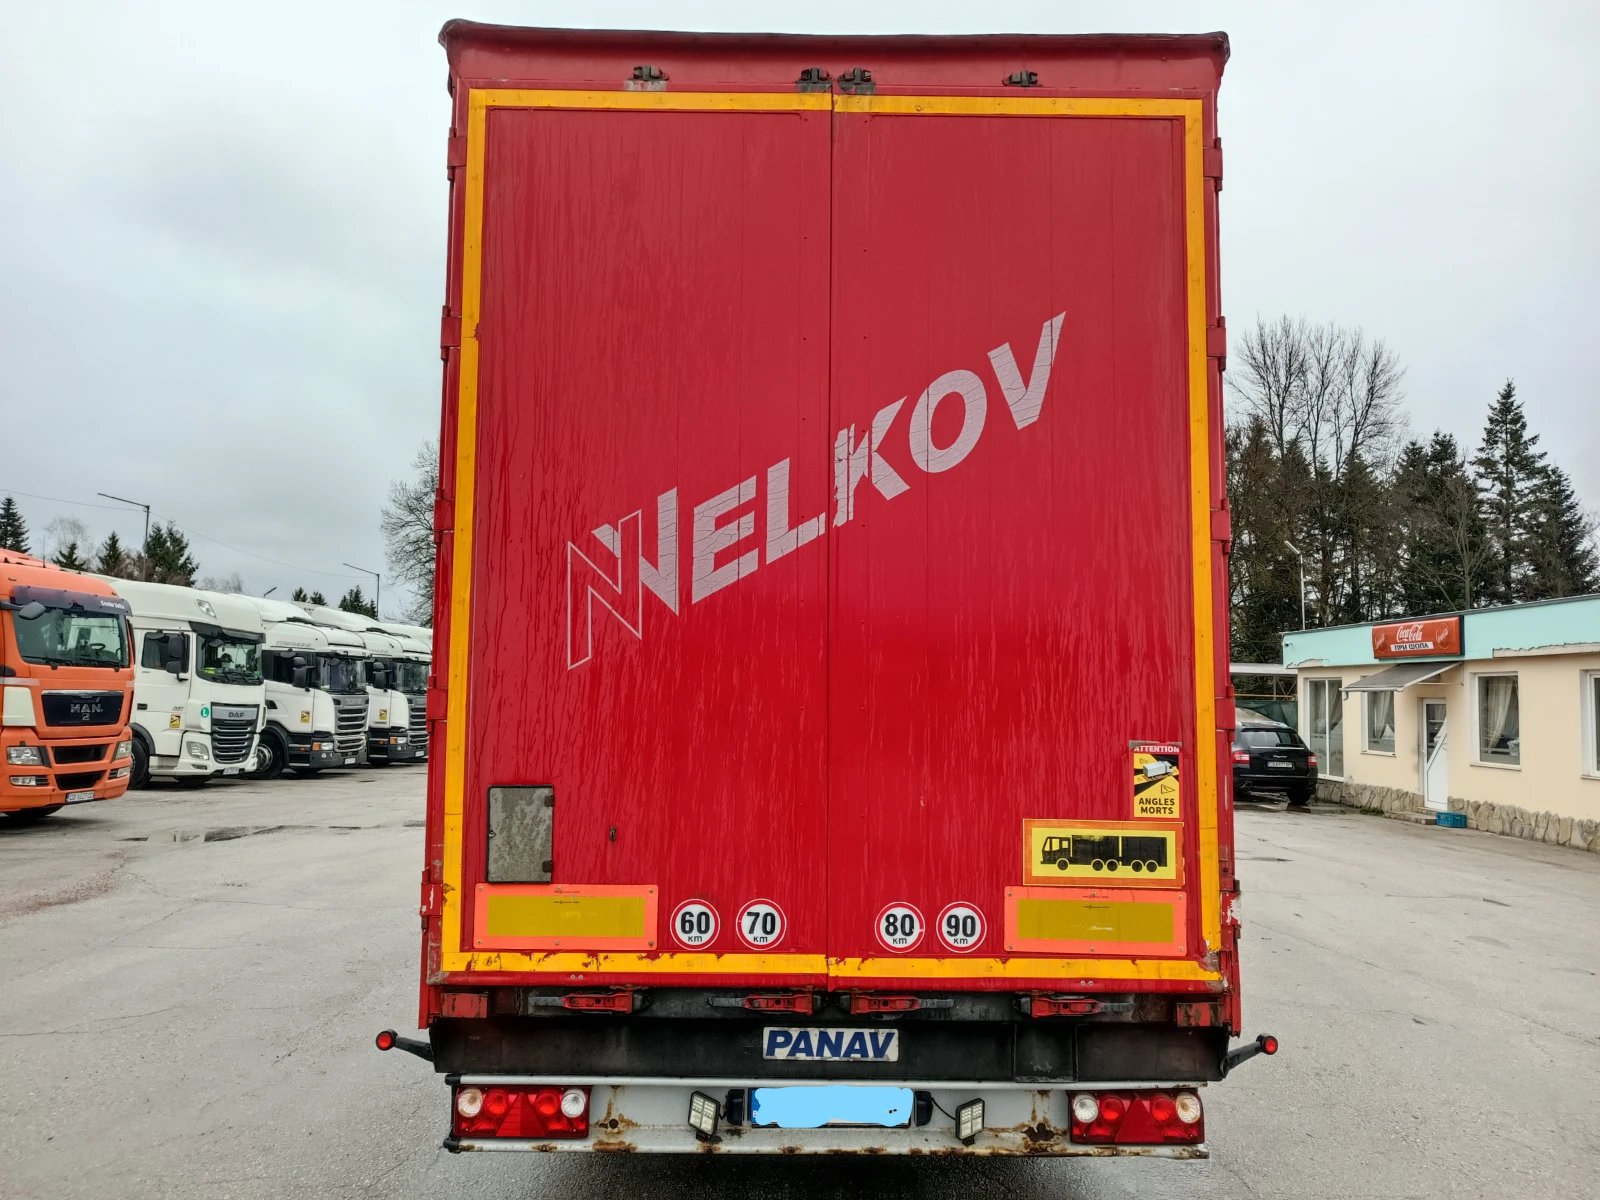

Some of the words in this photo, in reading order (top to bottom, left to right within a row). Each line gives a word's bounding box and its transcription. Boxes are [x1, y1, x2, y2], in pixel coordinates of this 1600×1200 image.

[1408, 642, 1429, 650] ШОПА
[70, 703, 102, 714] MAN
[1133, 745, 1180, 753] ATTENTION
[1138, 797, 1175, 806] ANGLES
[1140, 806, 1174, 815] MORTS
[680, 911, 710, 934] 60
[746, 911, 776, 935] 70
[885, 913, 915, 937] 80
[946, 914, 976, 937] 90
[765, 1030, 896, 1058] PANAV
